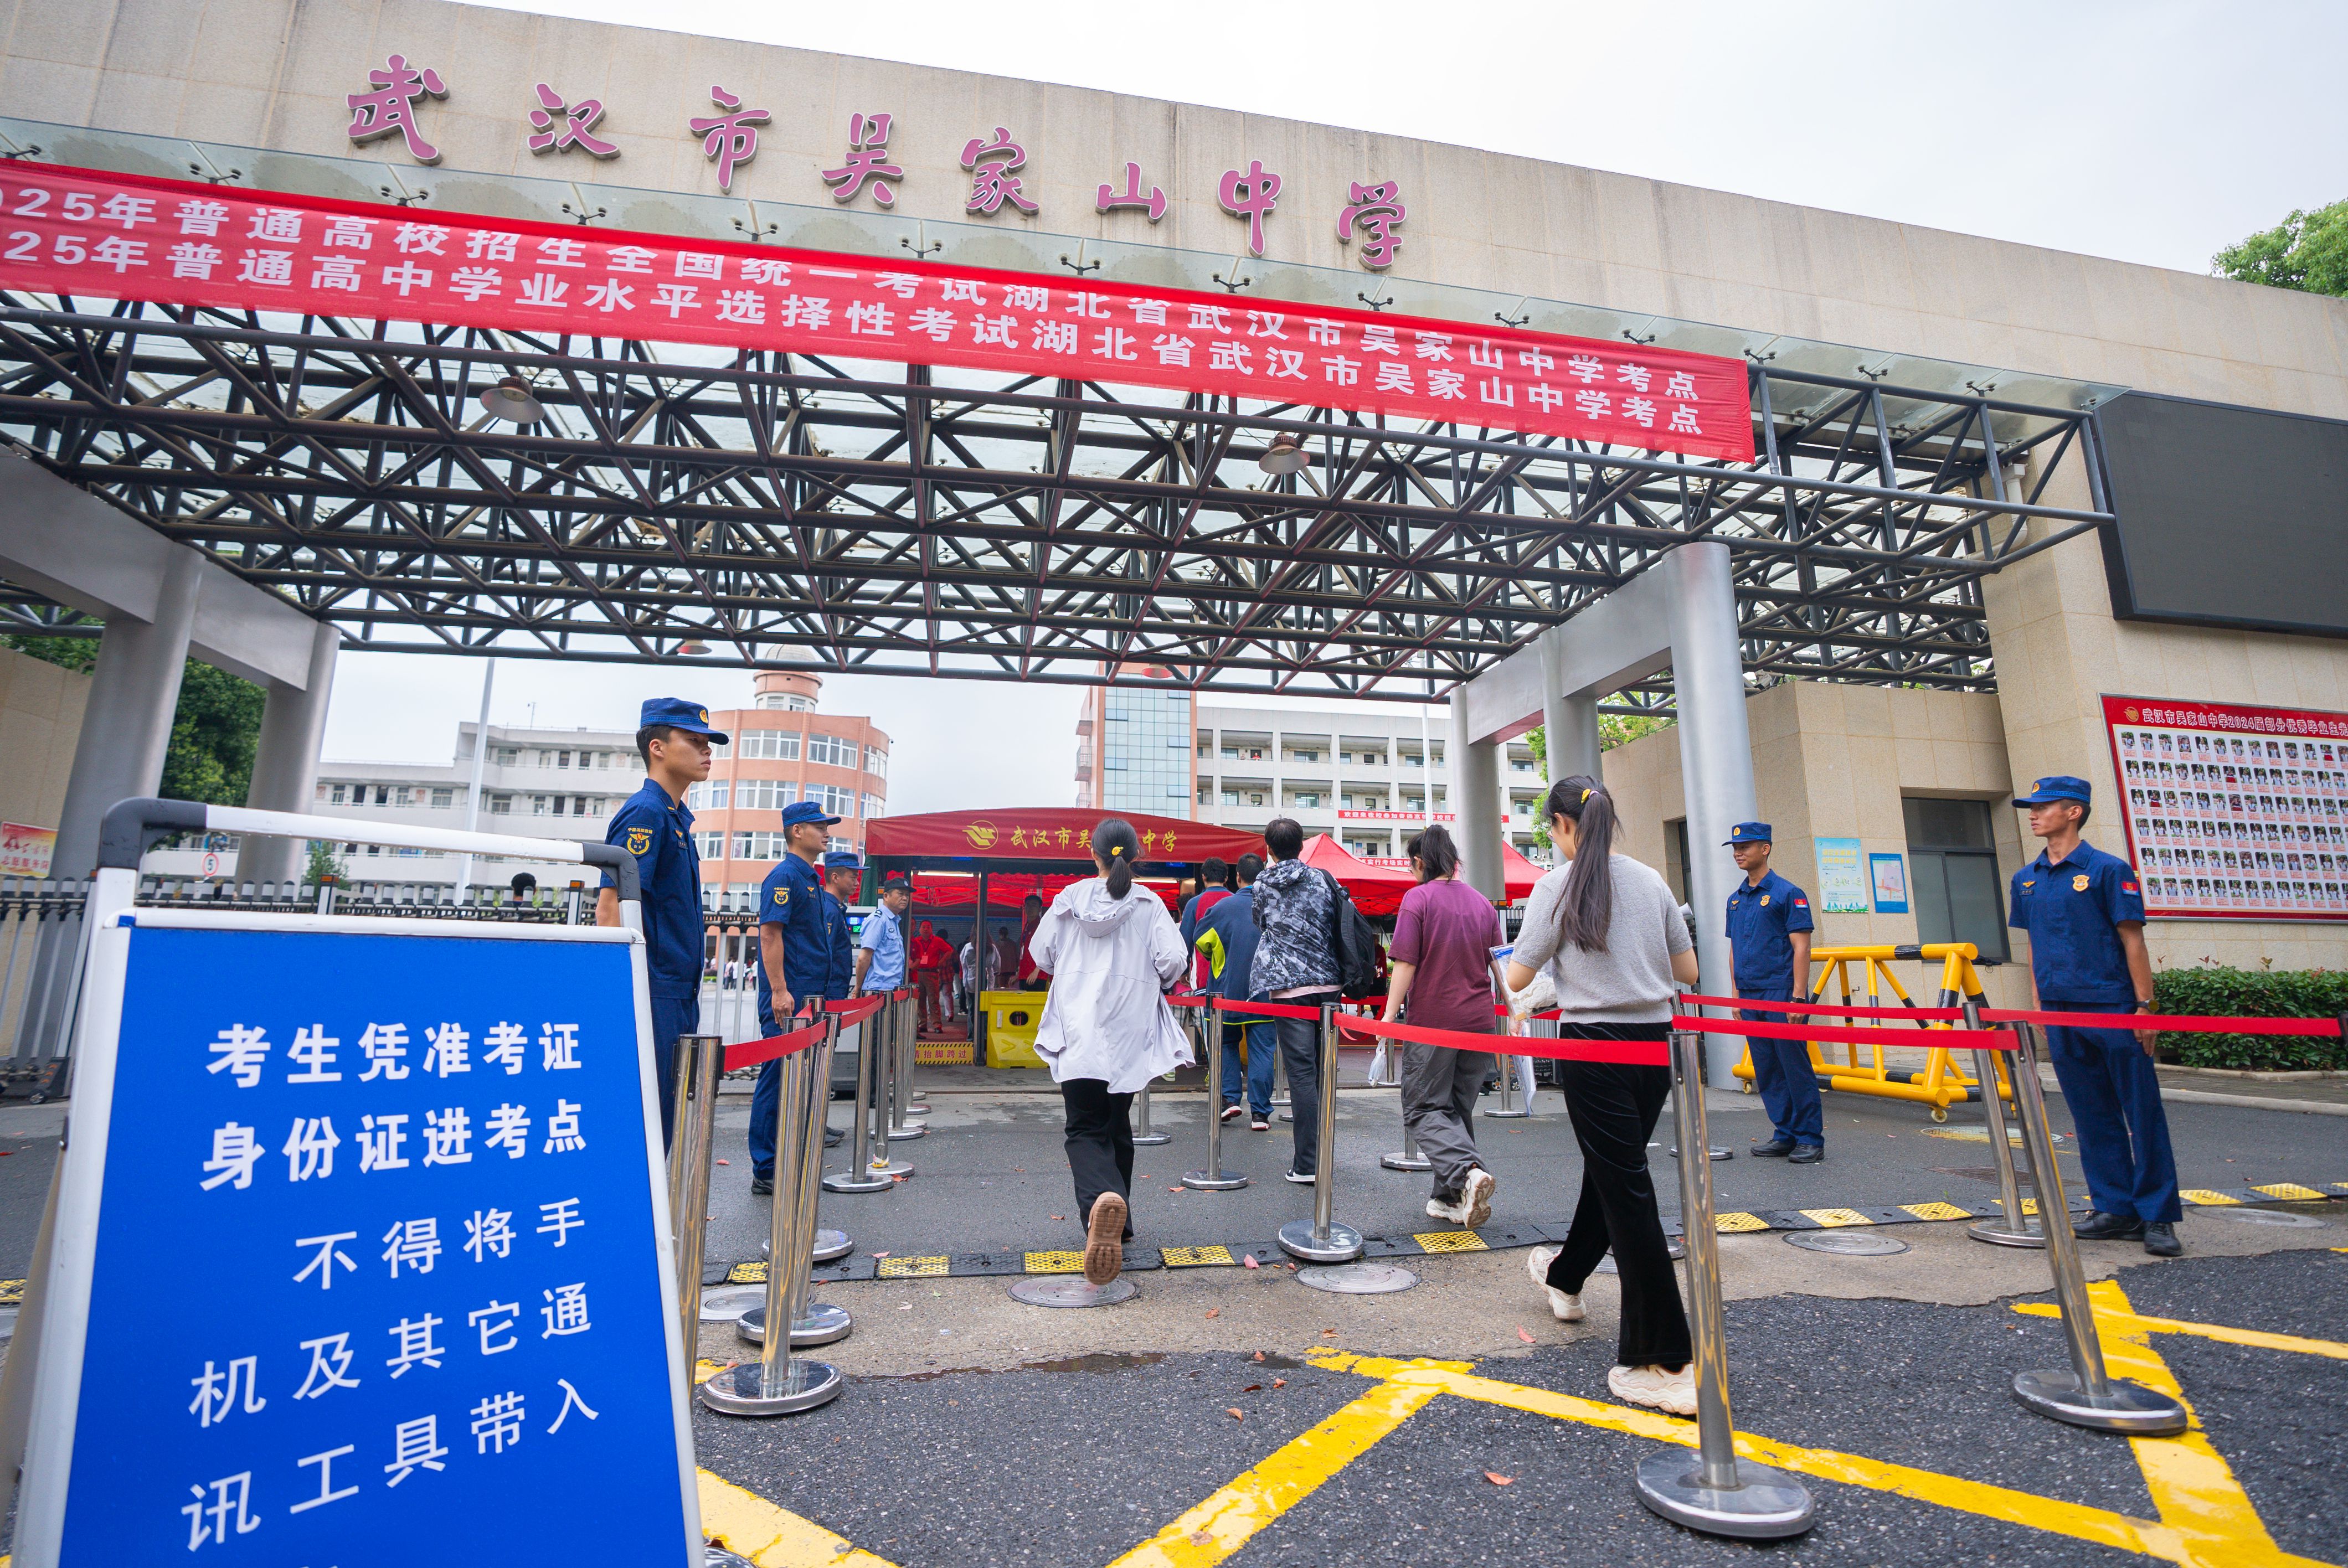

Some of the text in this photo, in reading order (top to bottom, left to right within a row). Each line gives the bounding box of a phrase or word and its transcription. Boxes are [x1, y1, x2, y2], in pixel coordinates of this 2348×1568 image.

[346, 54, 1407, 268] 武汉市吴家山中学
[0, 188, 1699, 401] 25年普通高校招生全国统一考试湖北省武汉市吴家山中学考点
[4, 231, 1703, 435] 25年普通高中学业水平选择性考试湖北省武汉市吴家山中学考点
[208, 859, 213, 871] 5
[1010, 826, 1177, 853] 武汉市吴中学
[206, 1021, 582, 1089] 考生凭准考证
[200, 1098, 587, 1191] 身份证进考点
[292, 1196, 585, 1290] 不得将手
[188, 1282, 591, 1428] 机及其它通
[181, 1378, 599, 1552] 讯工具带入
